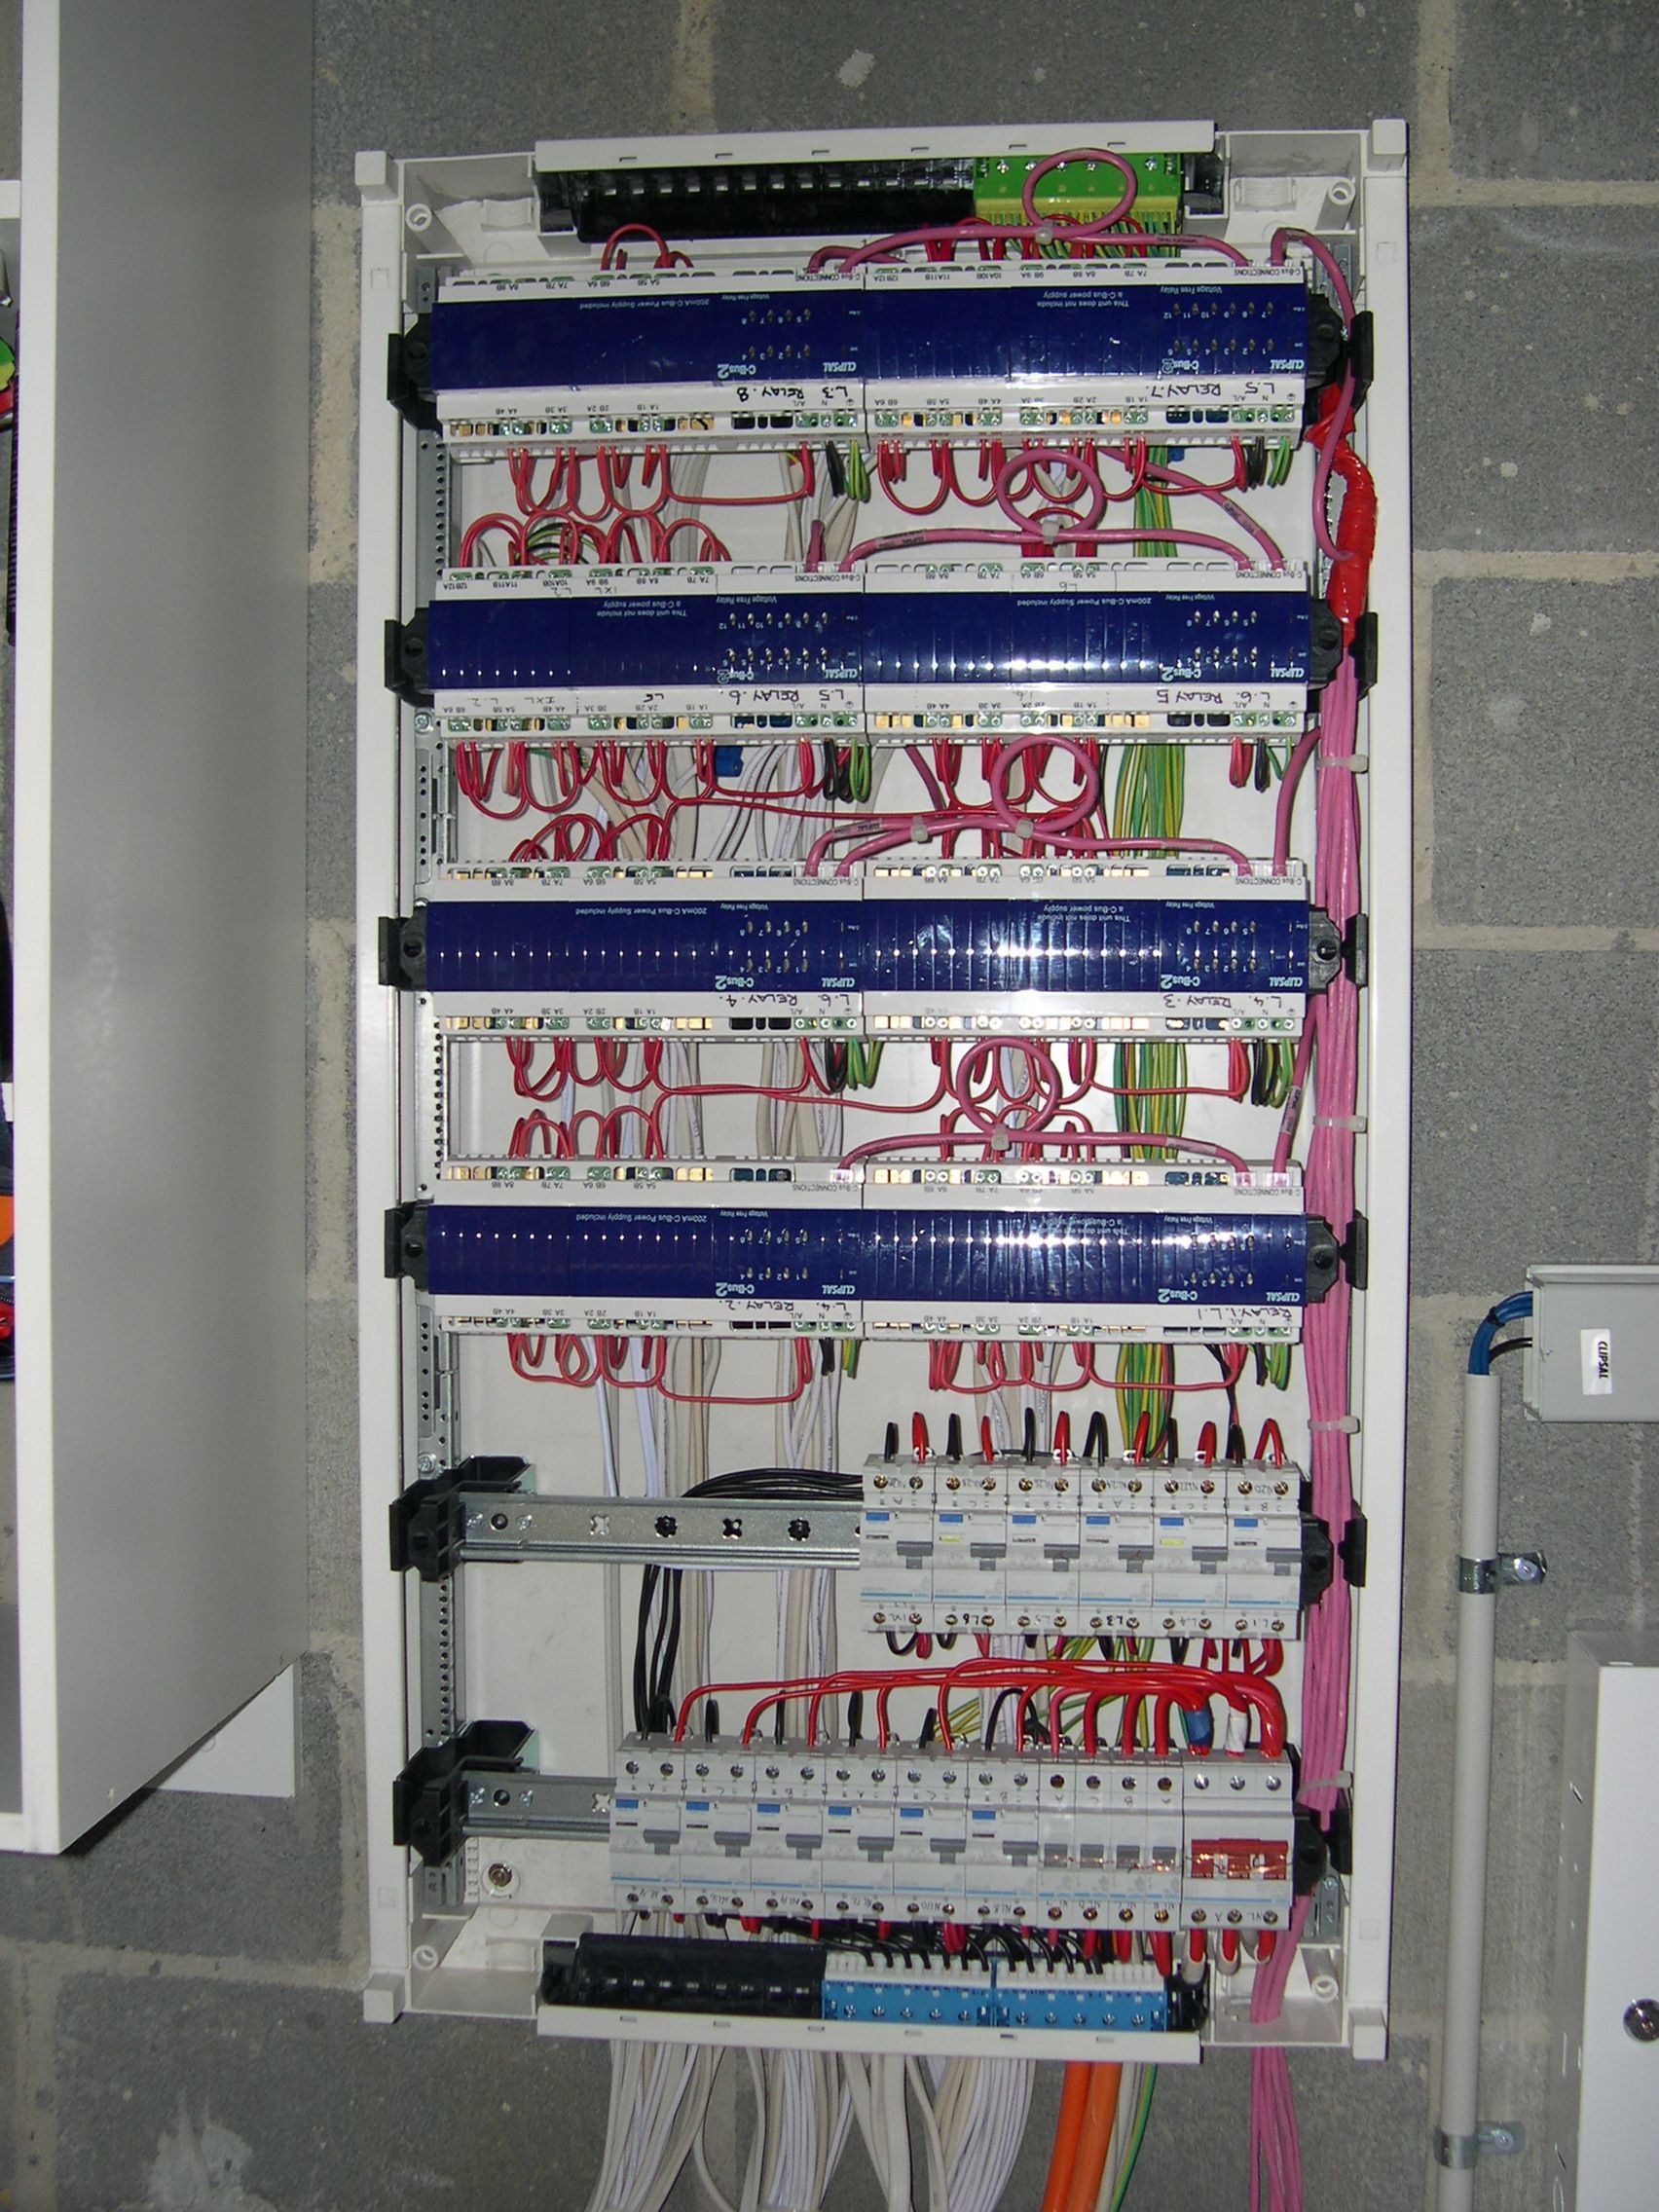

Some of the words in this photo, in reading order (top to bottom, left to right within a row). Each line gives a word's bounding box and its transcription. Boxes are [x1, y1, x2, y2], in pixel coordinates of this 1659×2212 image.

[1160, 285, 1178, 294] Relay
[1198, 285, 1222, 294] Voltage
[823, 362, 857, 372] CLIPSAL
[1271, 359, 1304, 370] CLIPSAL
[753, 595, 777, 604] Voltage
[824, 669, 858, 679] CLIPSAL
[1271, 667, 1305, 678] CLIPSAL
[1157, 689, 1168, 703] 5
[1176, 692, 1222, 703] RELAY
[821, 977, 855, 987] CLIPSAL
[1269, 977, 1303, 987] CLIPSAL
[822, 1284, 855, 1294] CLIPSAL
[1266, 1292, 1300, 1302] CLIPSAL
[1598, 1341, 1609, 1379] CLIPSAL
